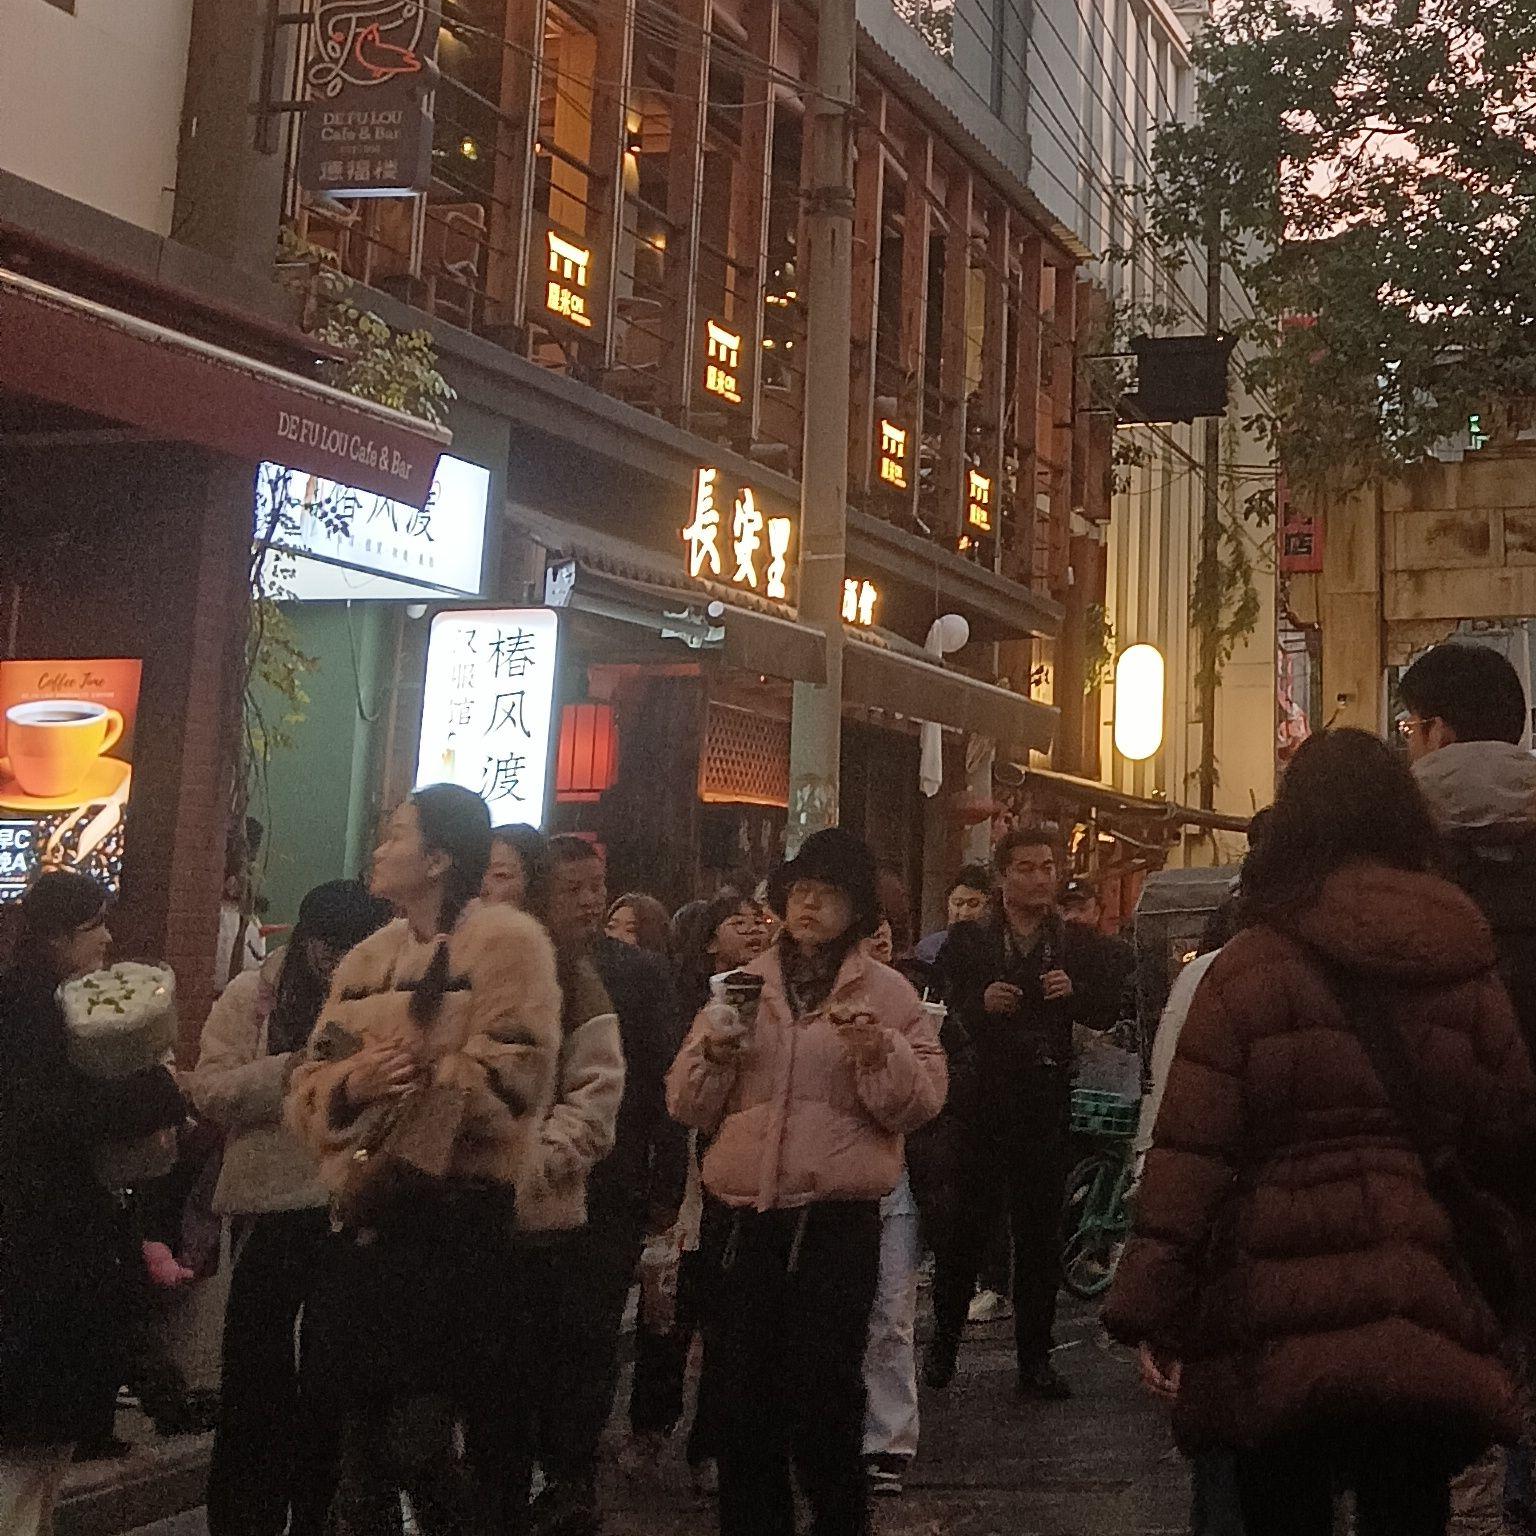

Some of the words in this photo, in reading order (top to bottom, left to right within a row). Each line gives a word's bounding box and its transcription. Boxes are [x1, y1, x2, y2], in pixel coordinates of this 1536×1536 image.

[277, 411, 300, 441] DE
[300, 418, 321, 448] FU
[320, 425, 349, 457] LOU
[349, 435, 378, 468] Cafe
[379, 446, 389, 472] &
[390, 450, 413, 480] Bar
[482, 627, 537, 802] 椿风渡
